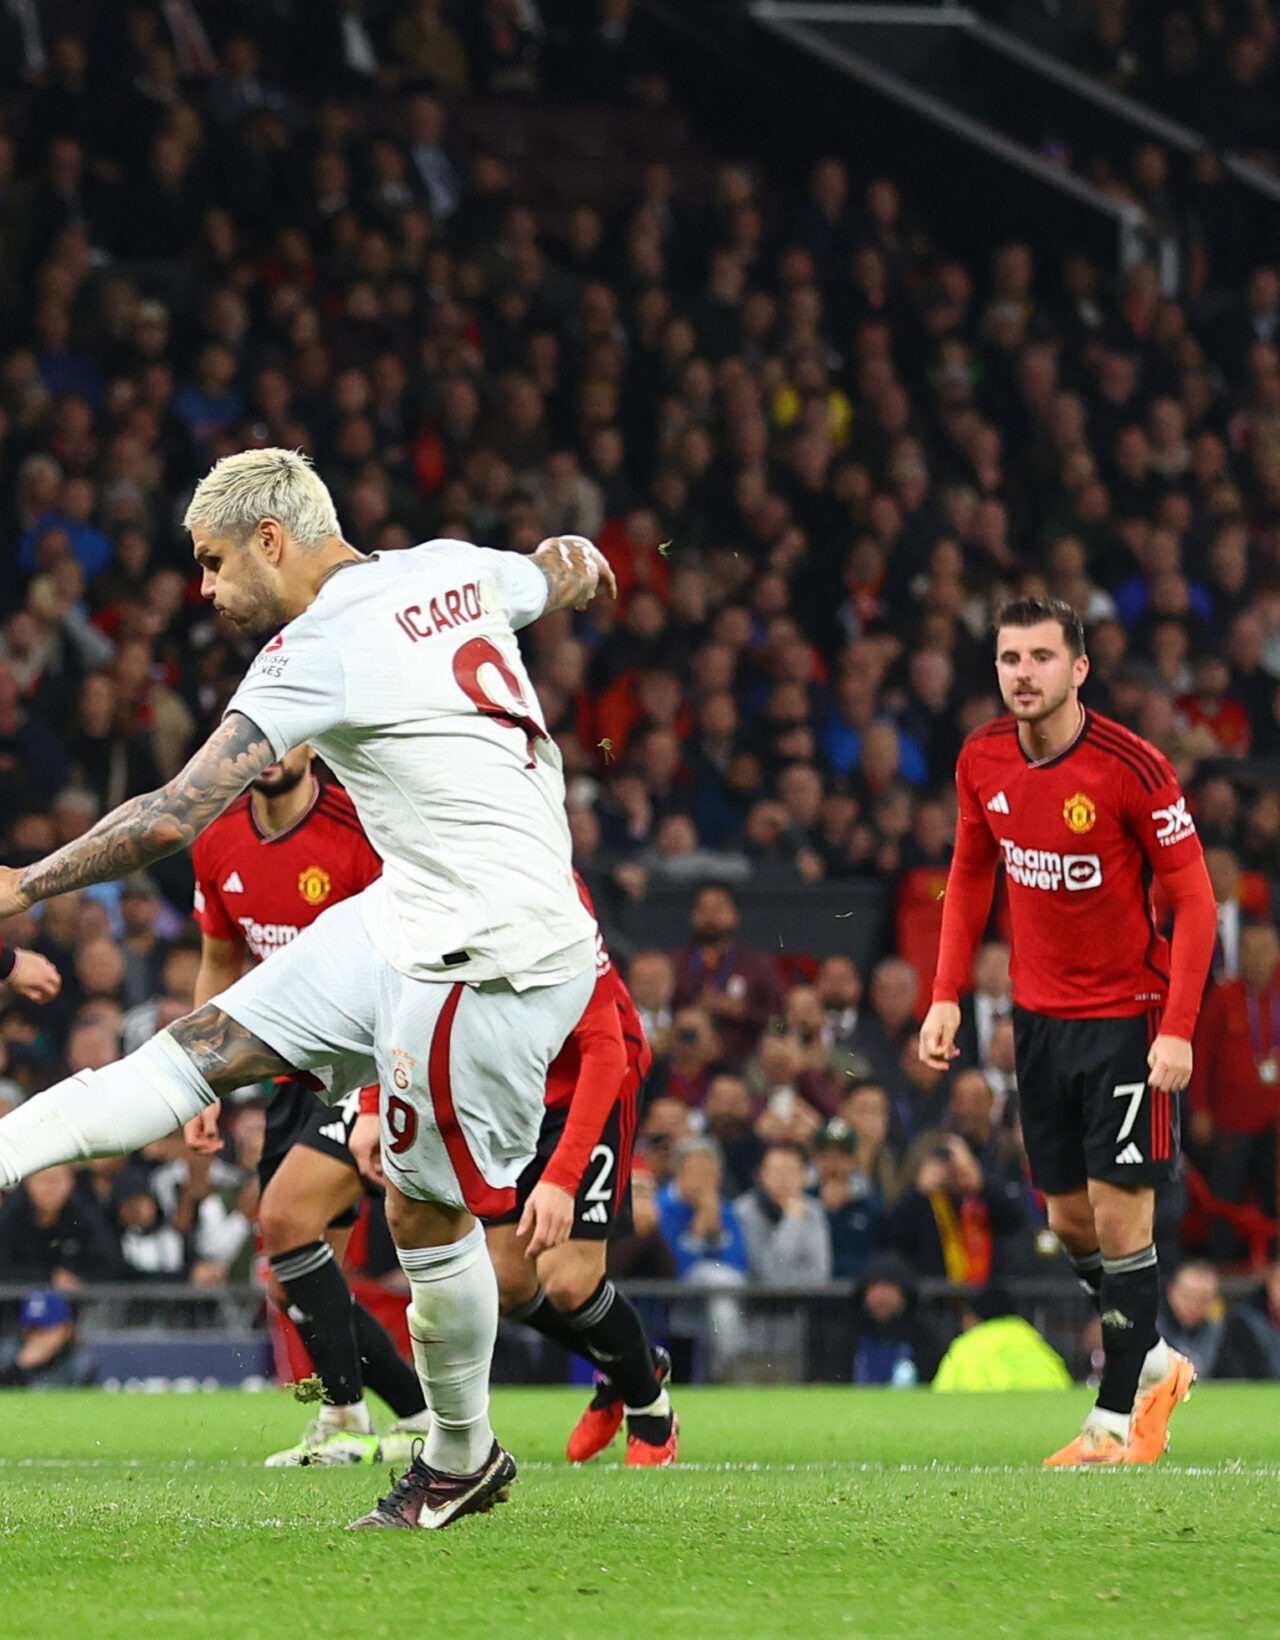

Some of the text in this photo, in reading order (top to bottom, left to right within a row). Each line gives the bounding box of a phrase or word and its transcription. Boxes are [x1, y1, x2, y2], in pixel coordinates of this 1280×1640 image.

[999, 837, 1062, 873] Team
[237, 916, 300, 946] Team
[386, 1095, 419, 1154] 9
[1112, 1081, 1146, 1145] 7
[584, 1143, 616, 1201] 2
